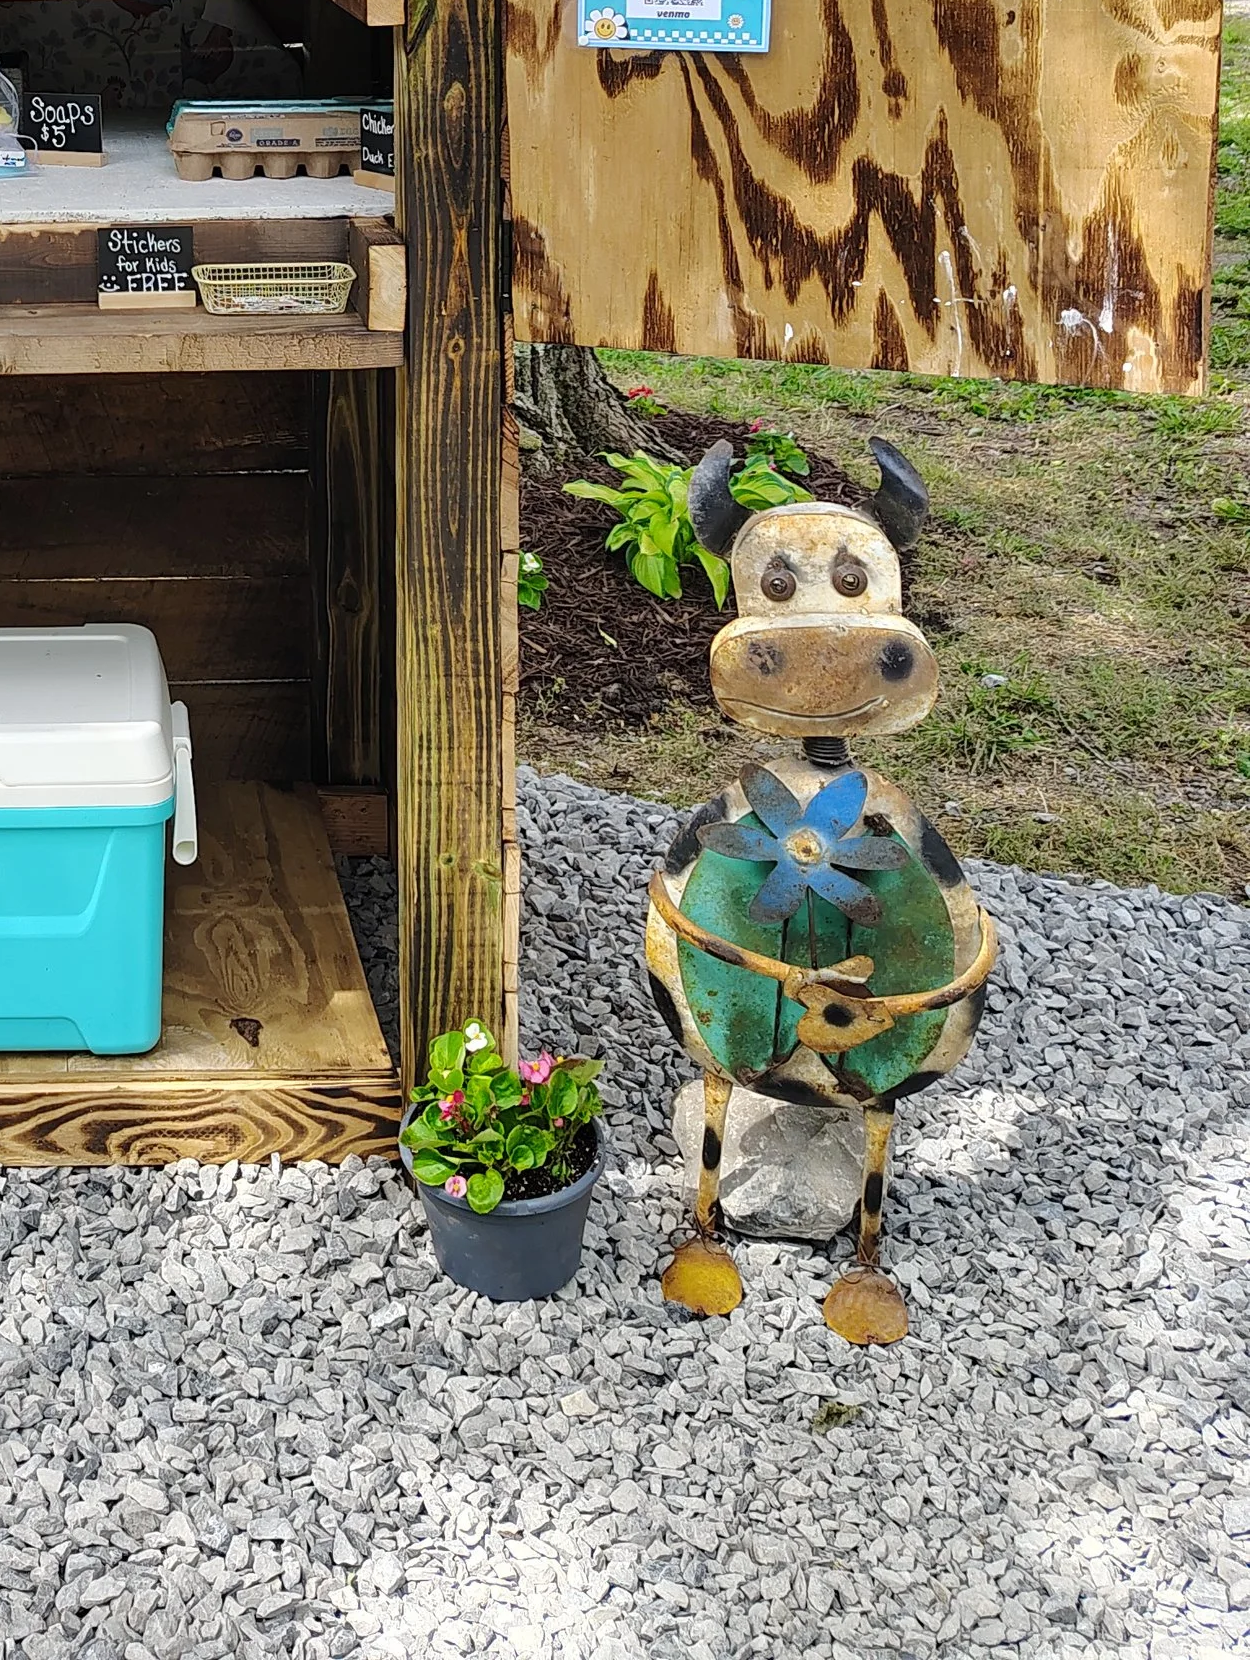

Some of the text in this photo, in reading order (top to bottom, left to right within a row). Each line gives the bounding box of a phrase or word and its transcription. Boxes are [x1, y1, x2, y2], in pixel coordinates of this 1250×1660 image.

[30, 96, 95, 133] Soaps
[40, 124, 66, 148] $5
[362, 146, 385, 165] Duck
[108, 229, 181, 254] Stickers
[116, 255, 177, 273] for Kids
[126, 271, 190, 292] FREE
